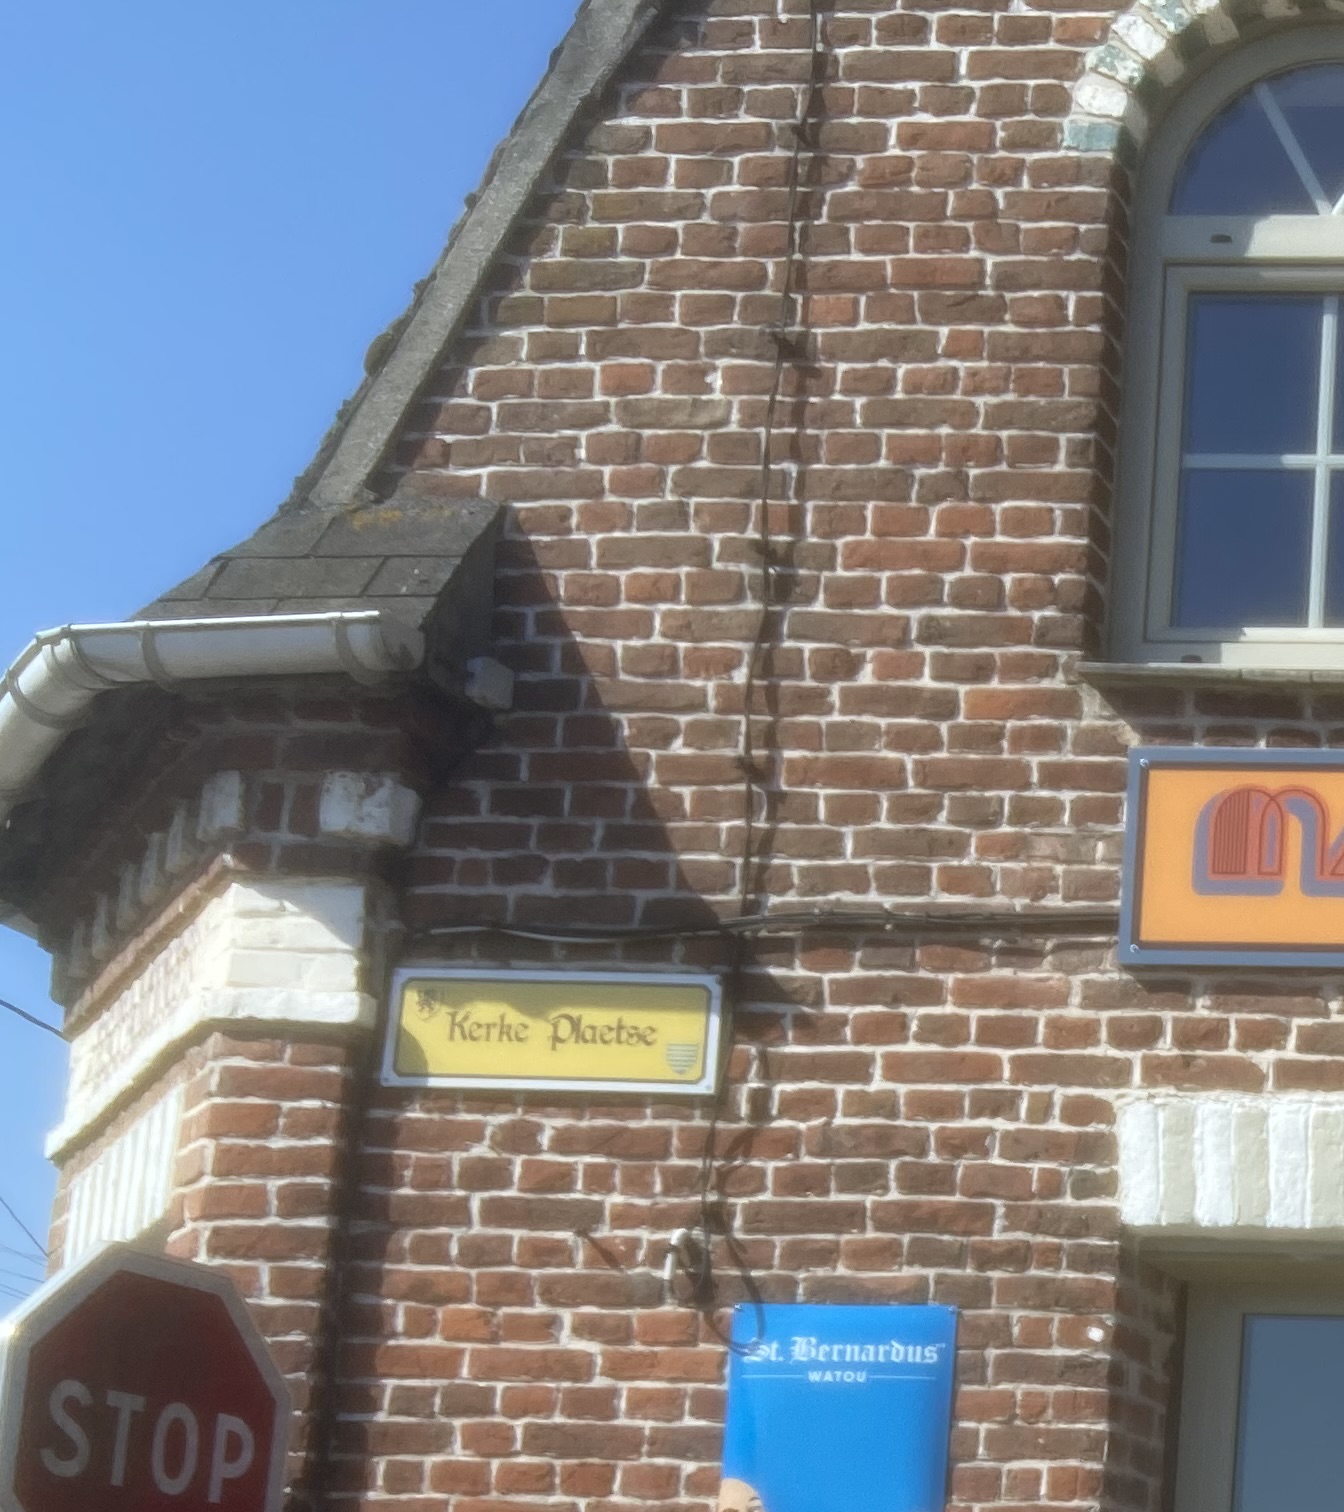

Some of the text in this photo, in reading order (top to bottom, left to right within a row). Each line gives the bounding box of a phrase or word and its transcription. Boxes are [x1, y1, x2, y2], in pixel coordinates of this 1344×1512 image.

[446, 1009, 658, 1052] Kerke Plaetse
[743, 1336, 940, 1363] St. Bernardus
[807, 1370, 868, 1383] WATOU
[40, 1378, 256, 1504] STOP
